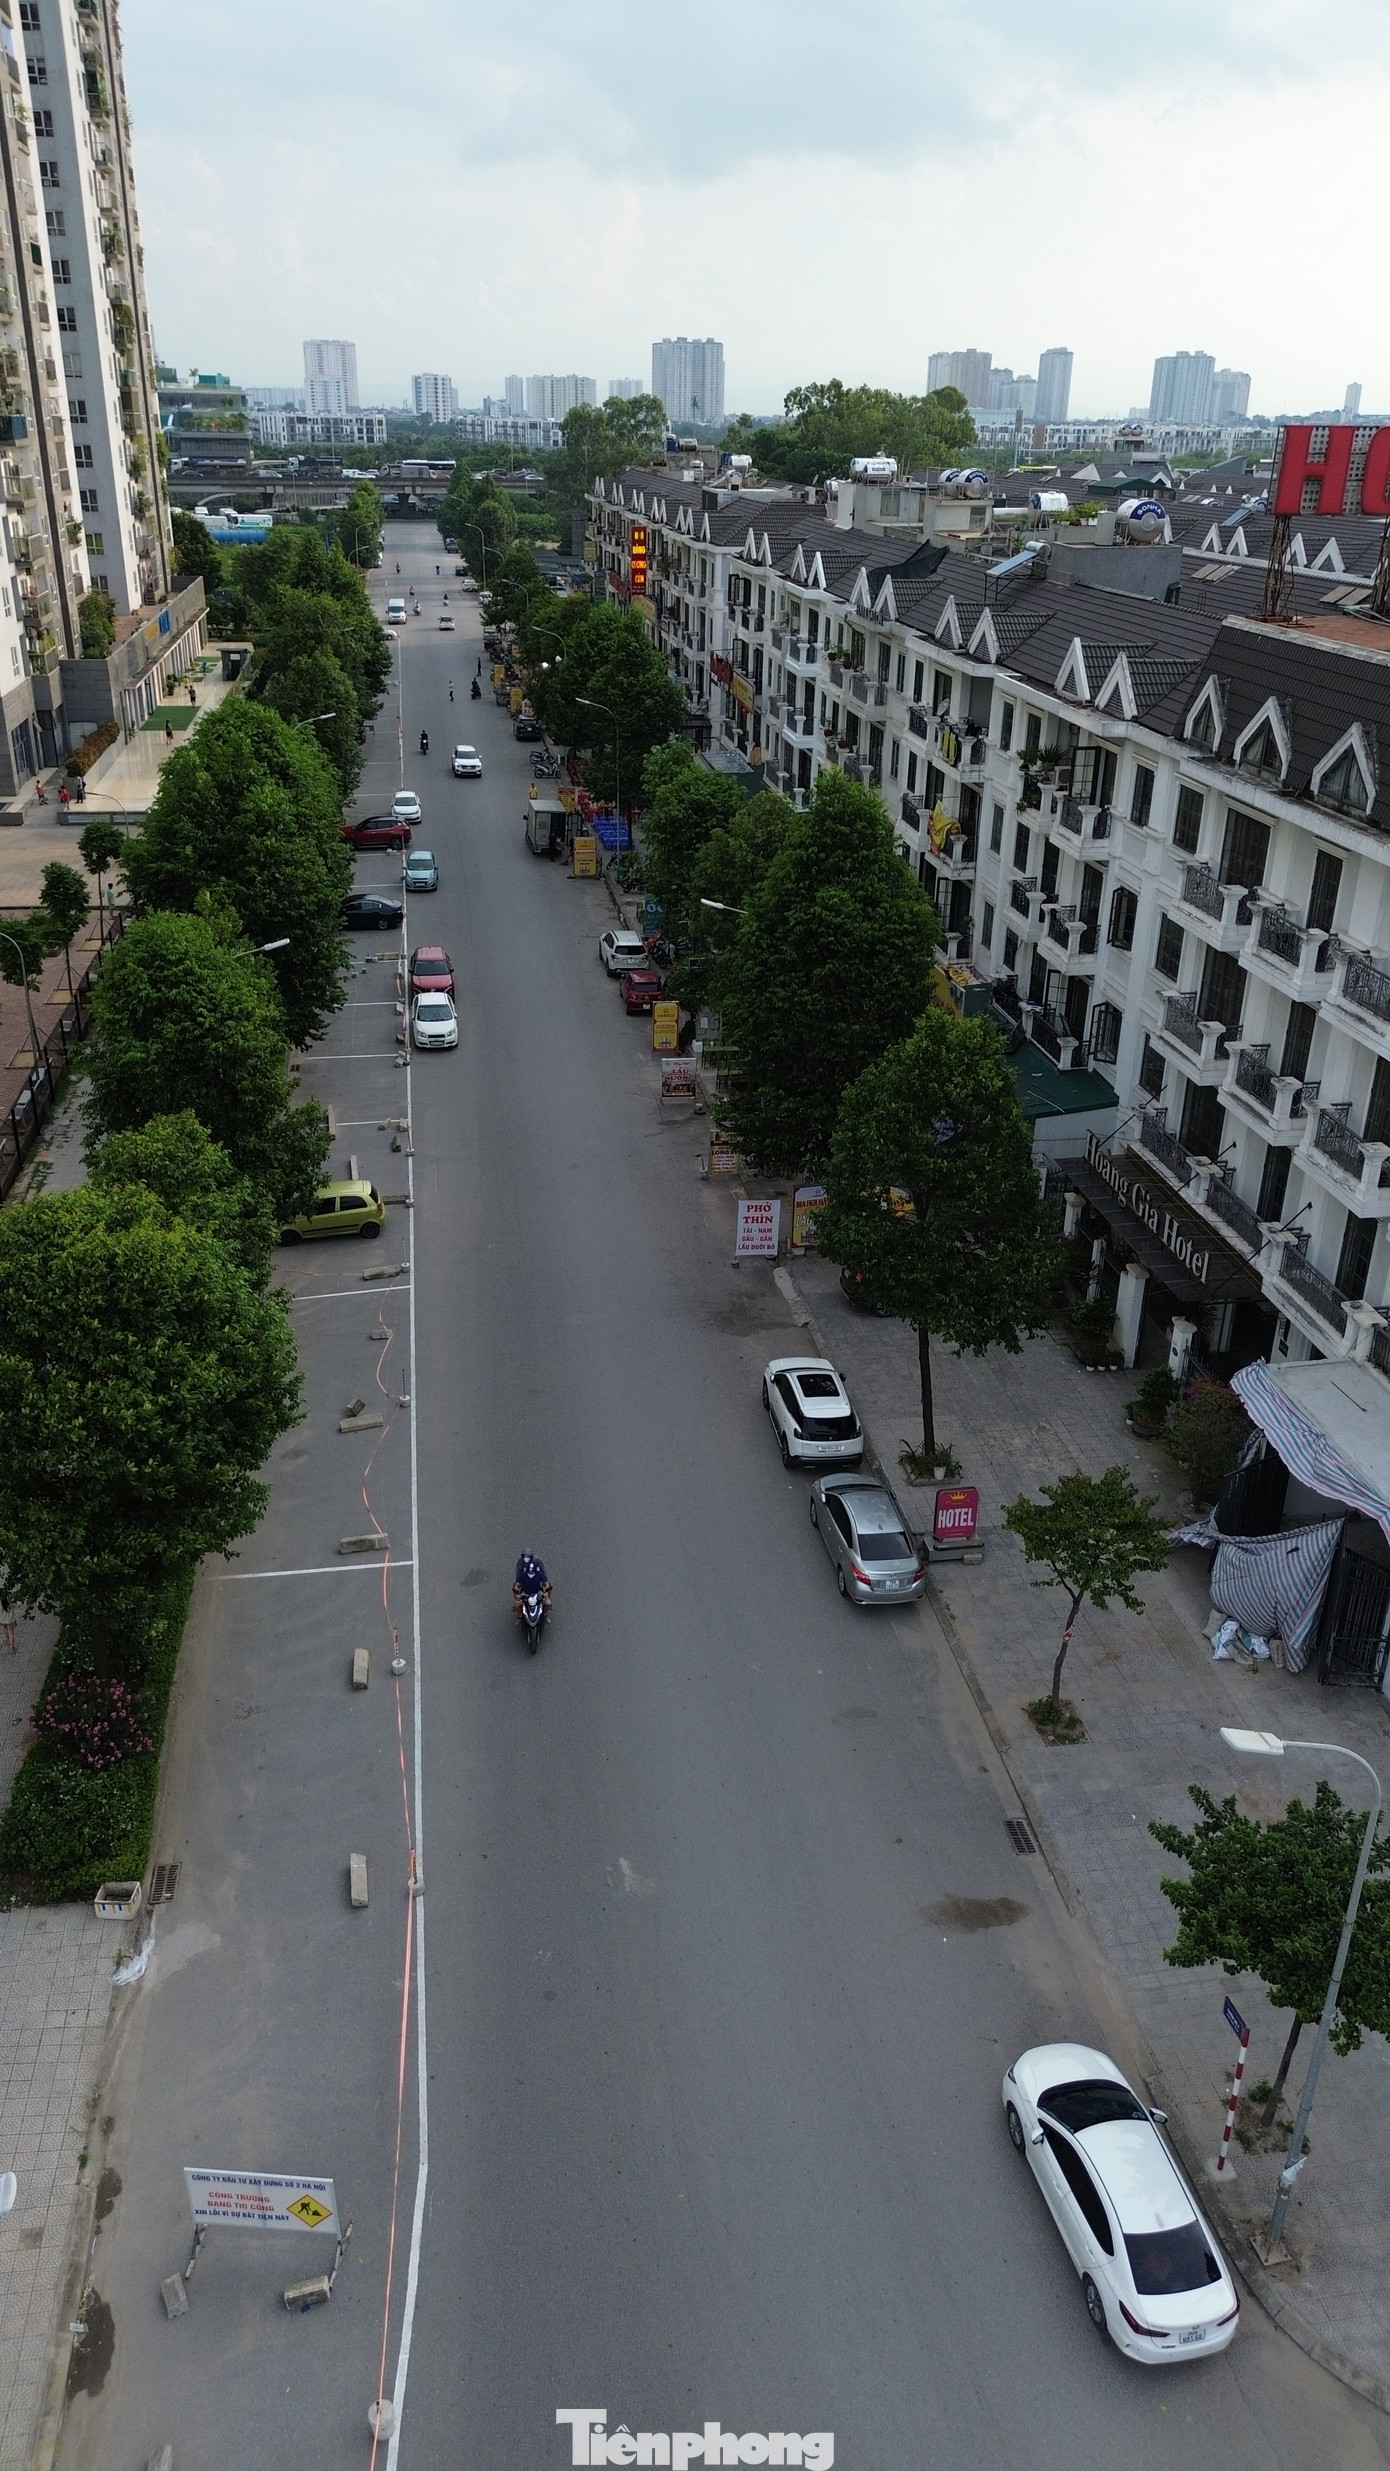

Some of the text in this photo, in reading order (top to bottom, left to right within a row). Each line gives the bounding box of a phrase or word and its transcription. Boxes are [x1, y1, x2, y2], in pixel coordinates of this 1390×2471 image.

[746, 1202, 772, 1212] PHỞ
[742, 1214, 774, 1224] THÌN
[1132, 1183, 1158, 1234] Gia
[1162, 1211, 1209, 1285] Hotel
[938, 1508, 974, 1529] HOTEL
[191, 2174, 211, 2182] CÔNG
[208, 2191, 233, 2199] CÔNG
[250, 2203, 274, 2212] CÔNG
